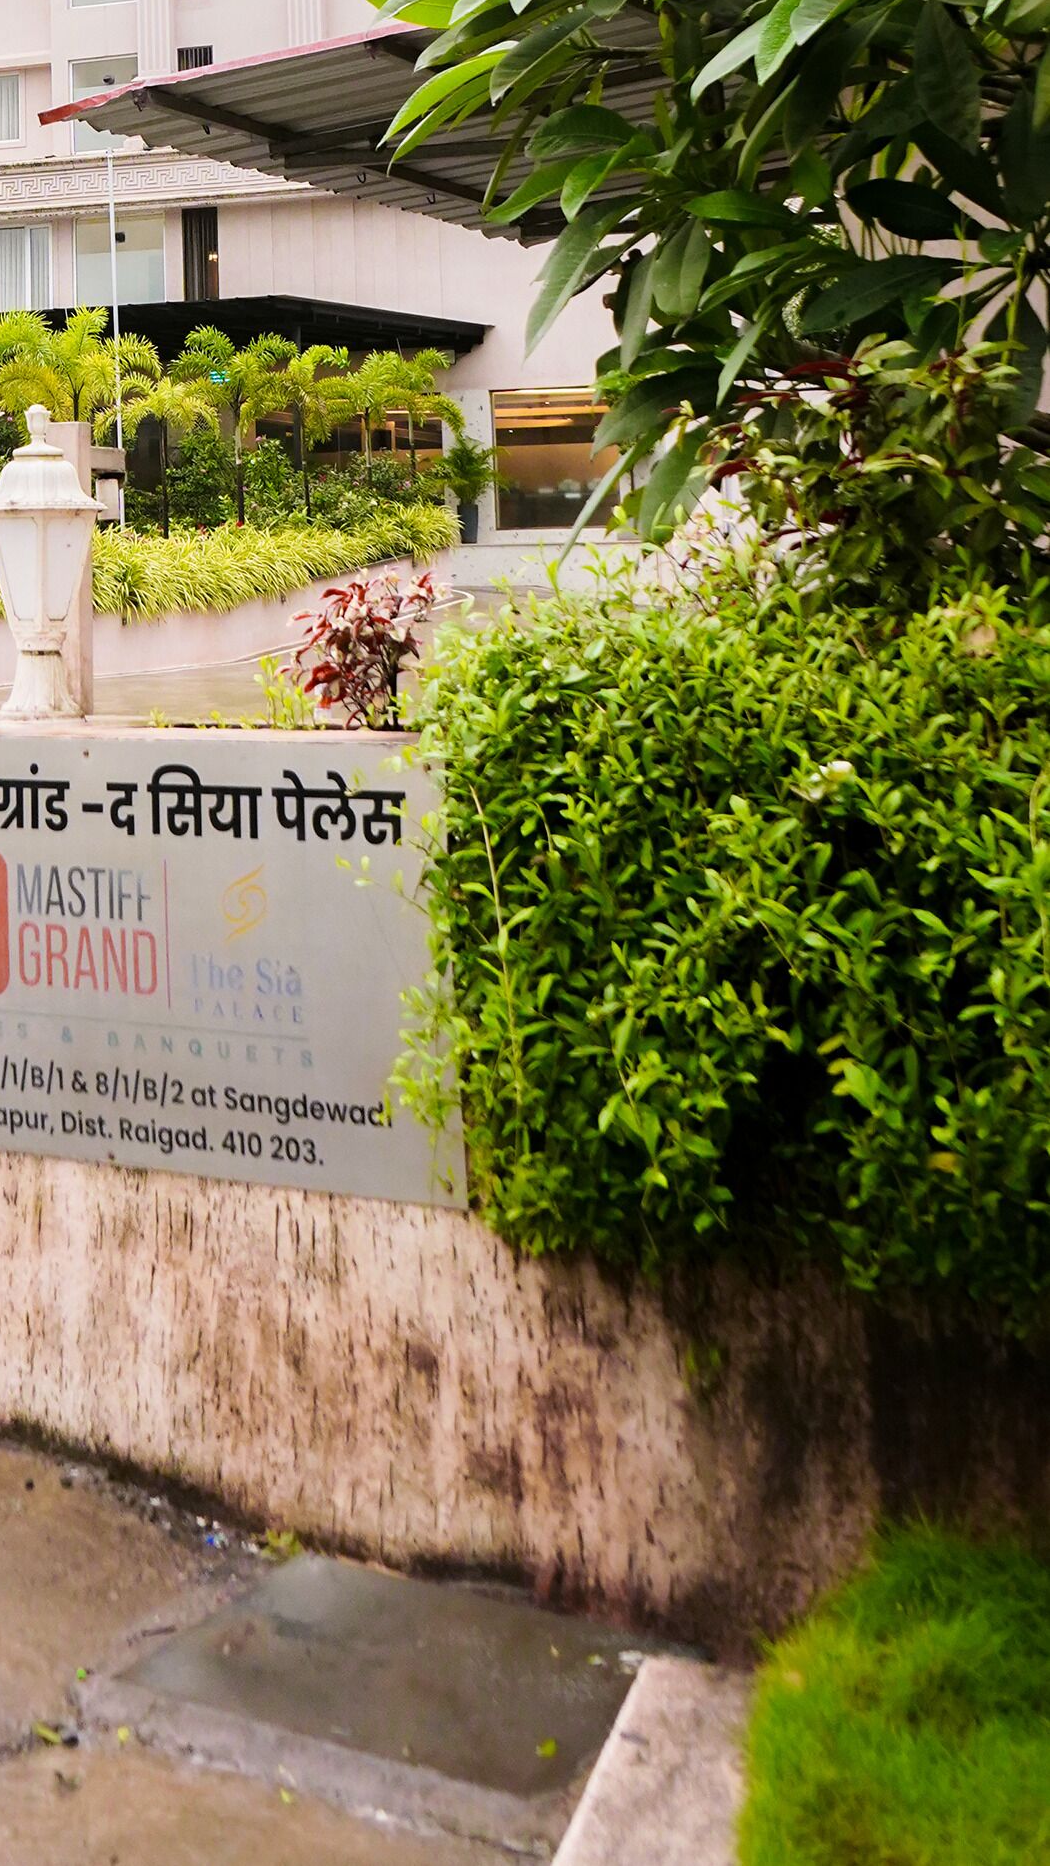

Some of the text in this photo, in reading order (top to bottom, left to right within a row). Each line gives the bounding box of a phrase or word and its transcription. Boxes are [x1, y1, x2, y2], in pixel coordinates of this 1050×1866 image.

[146, 764, 262, 839] सिया
[271, 769, 406, 845] पेलेस
[16, 863, 151, 921] MASTIFF
[18, 921, 158, 995] GRAND
[255, 958, 303, 997] Sia
[194, 997, 303, 1025] PALACE
[61, 1026, 73, 1043] &
[107, 1031, 314, 1068] BANQUETS
[71, 1070, 89, 1094] &
[95, 1066, 185, 1107] 8/1/B/2
[191, 1085, 218, 1109] at
[60, 1110, 112, 1139] Dist.
[119, 1117, 214, 1154] Raigad.
[221, 1130, 263, 1158] 410
[269, 1134, 325, 1166] 203.
